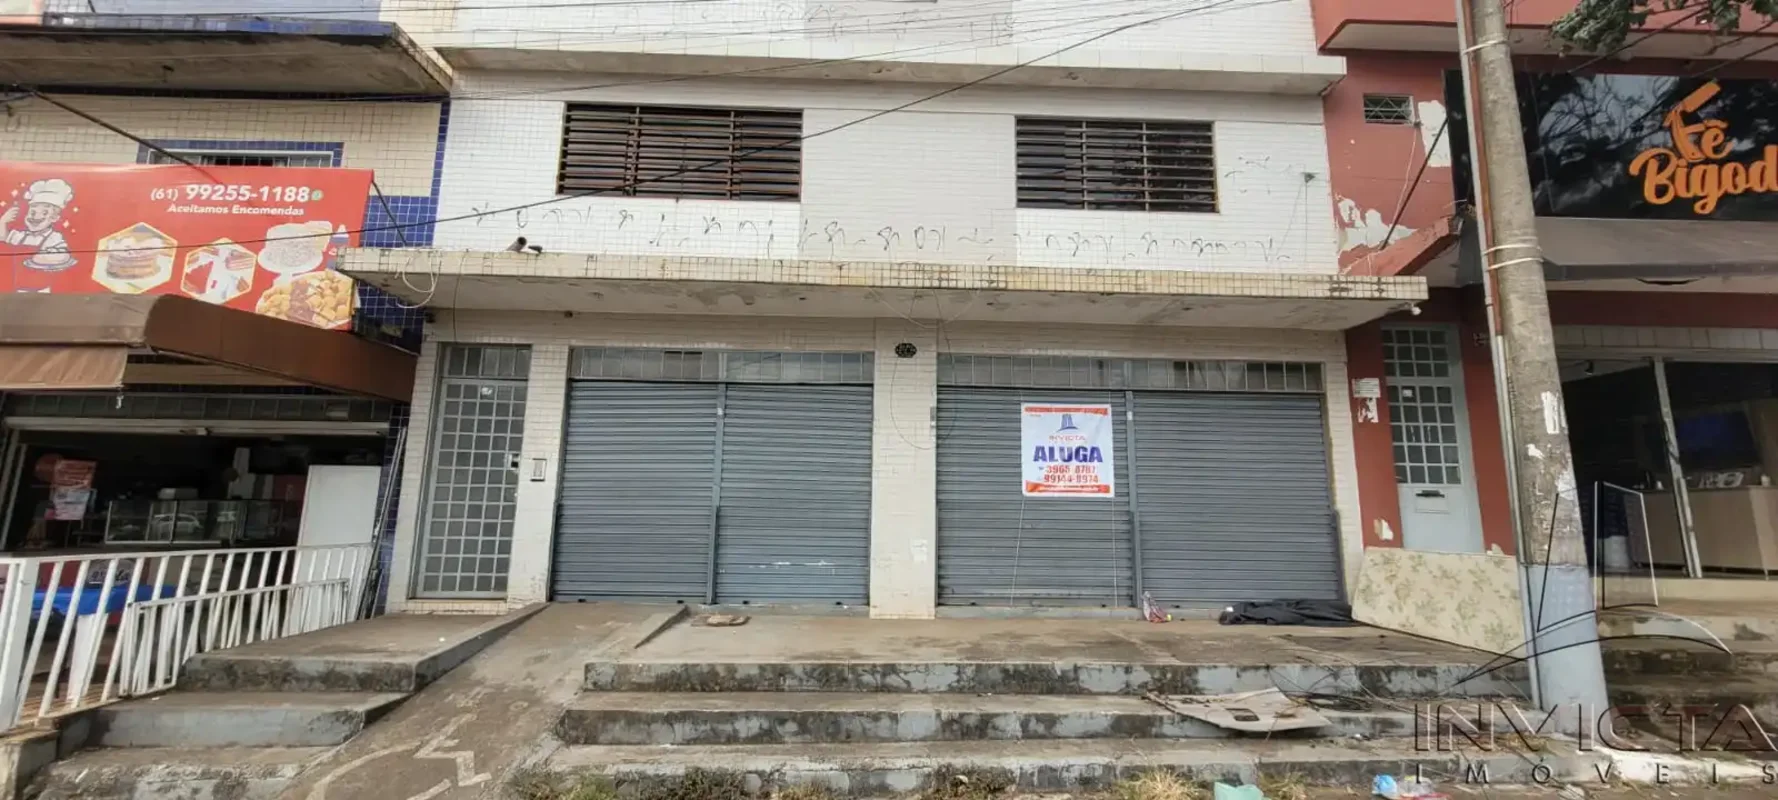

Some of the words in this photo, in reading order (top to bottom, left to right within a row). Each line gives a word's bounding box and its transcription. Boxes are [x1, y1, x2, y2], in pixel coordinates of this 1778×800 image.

[151, 188, 179, 201] (61)
[186, 184, 310, 202] 99255-1188
[167, 204, 229, 214] Aceitamos
[232, 206, 304, 216] Encomendas
[1033, 446, 1103, 462] ALUGA
